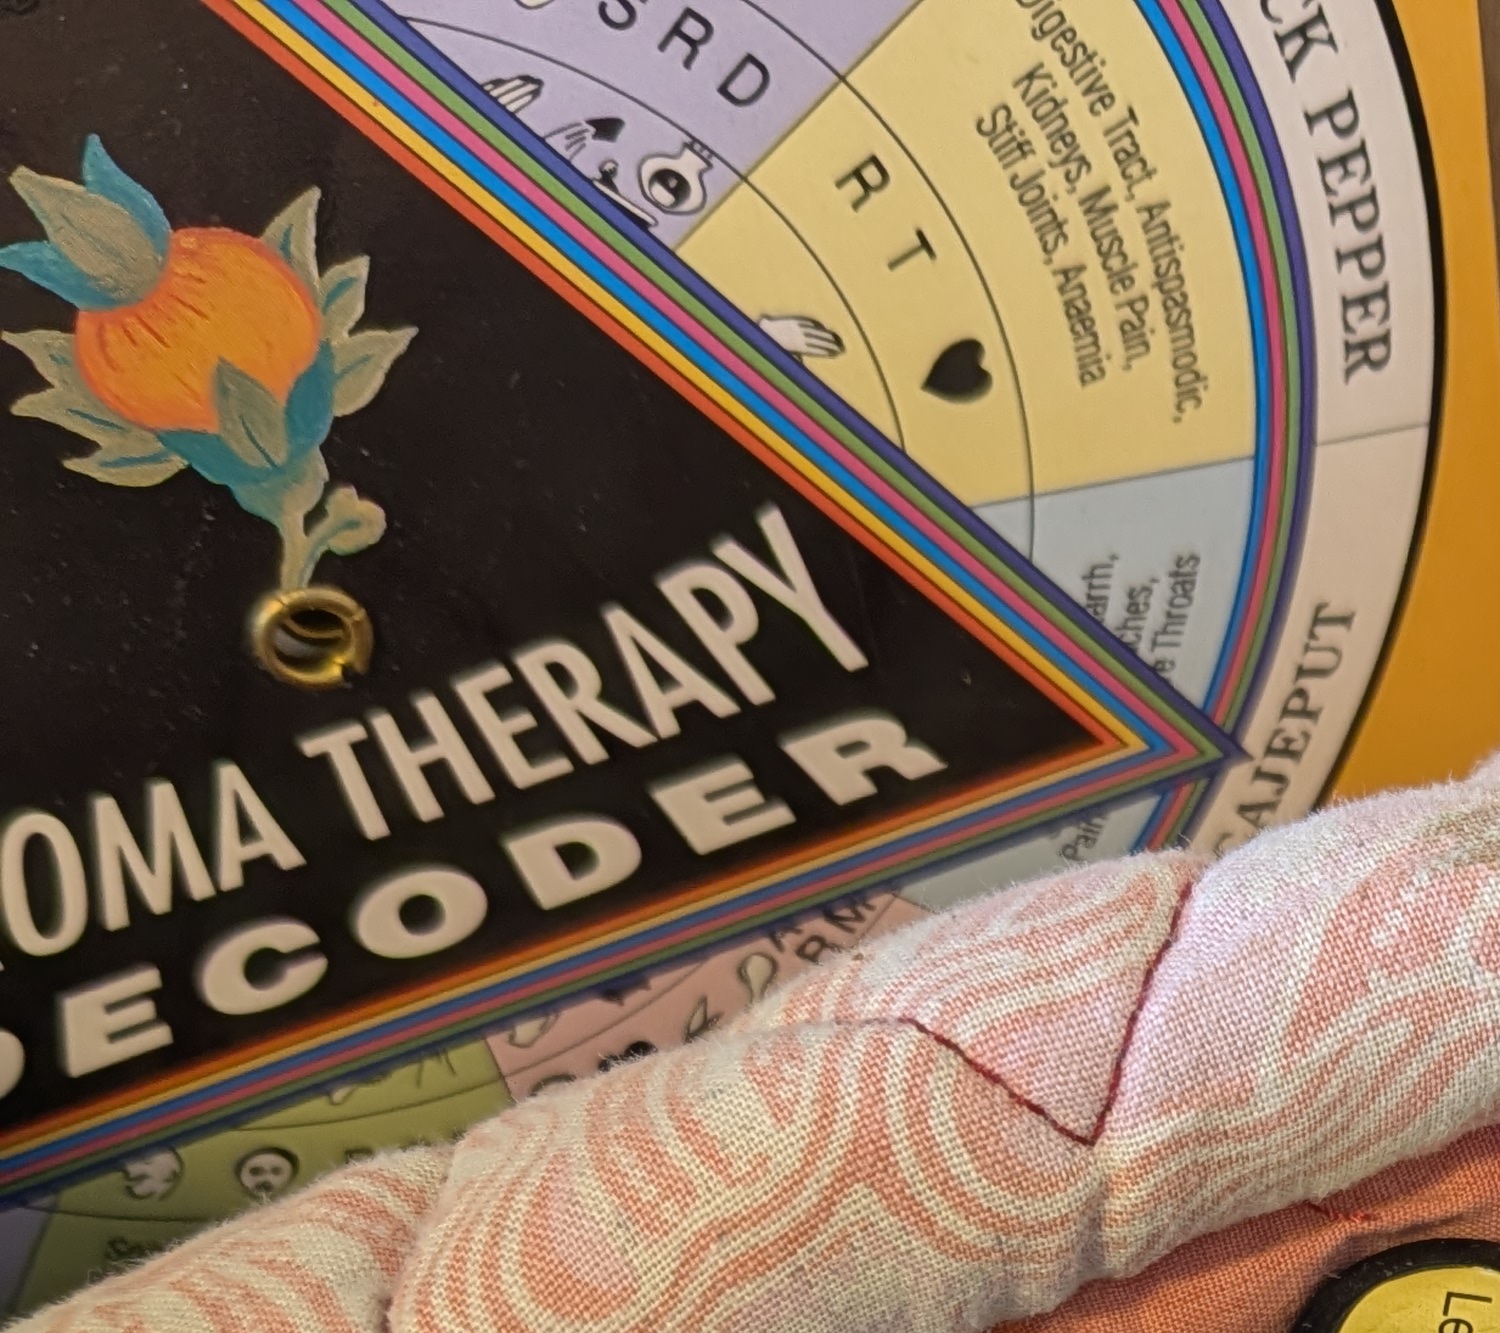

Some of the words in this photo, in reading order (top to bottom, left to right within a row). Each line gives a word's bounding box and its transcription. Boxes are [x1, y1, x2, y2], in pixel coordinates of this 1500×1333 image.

[657, 7, 714, 71] R
[717, 53, 771, 107] D
[835, 154, 890, 213] R
[886, 228, 937, 272] T
[976, 103, 1036, 170] Stiff
[1010, 168, 1068, 265] Joints,
[1051, 264, 1112, 388] Anaemia
[1012, 62, 1092, 195] Kidneys,
[1078, 184, 1138, 295] Muscle
[1115, 294, 1155, 371] Pain,
[1102, 105, 1158, 202] Tract,
[1136, 201, 1209, 423] Antispasmodic,
[1303, 88, 1392, 385] PEPPER
[1081, 554, 1119, 623] arrh,
[1115, 578, 1159, 653] ches,
[1151, 555, 1200, 653] Throats
[0, 758, 307, 958] OMA
[296, 503, 869, 842] THERAPY
